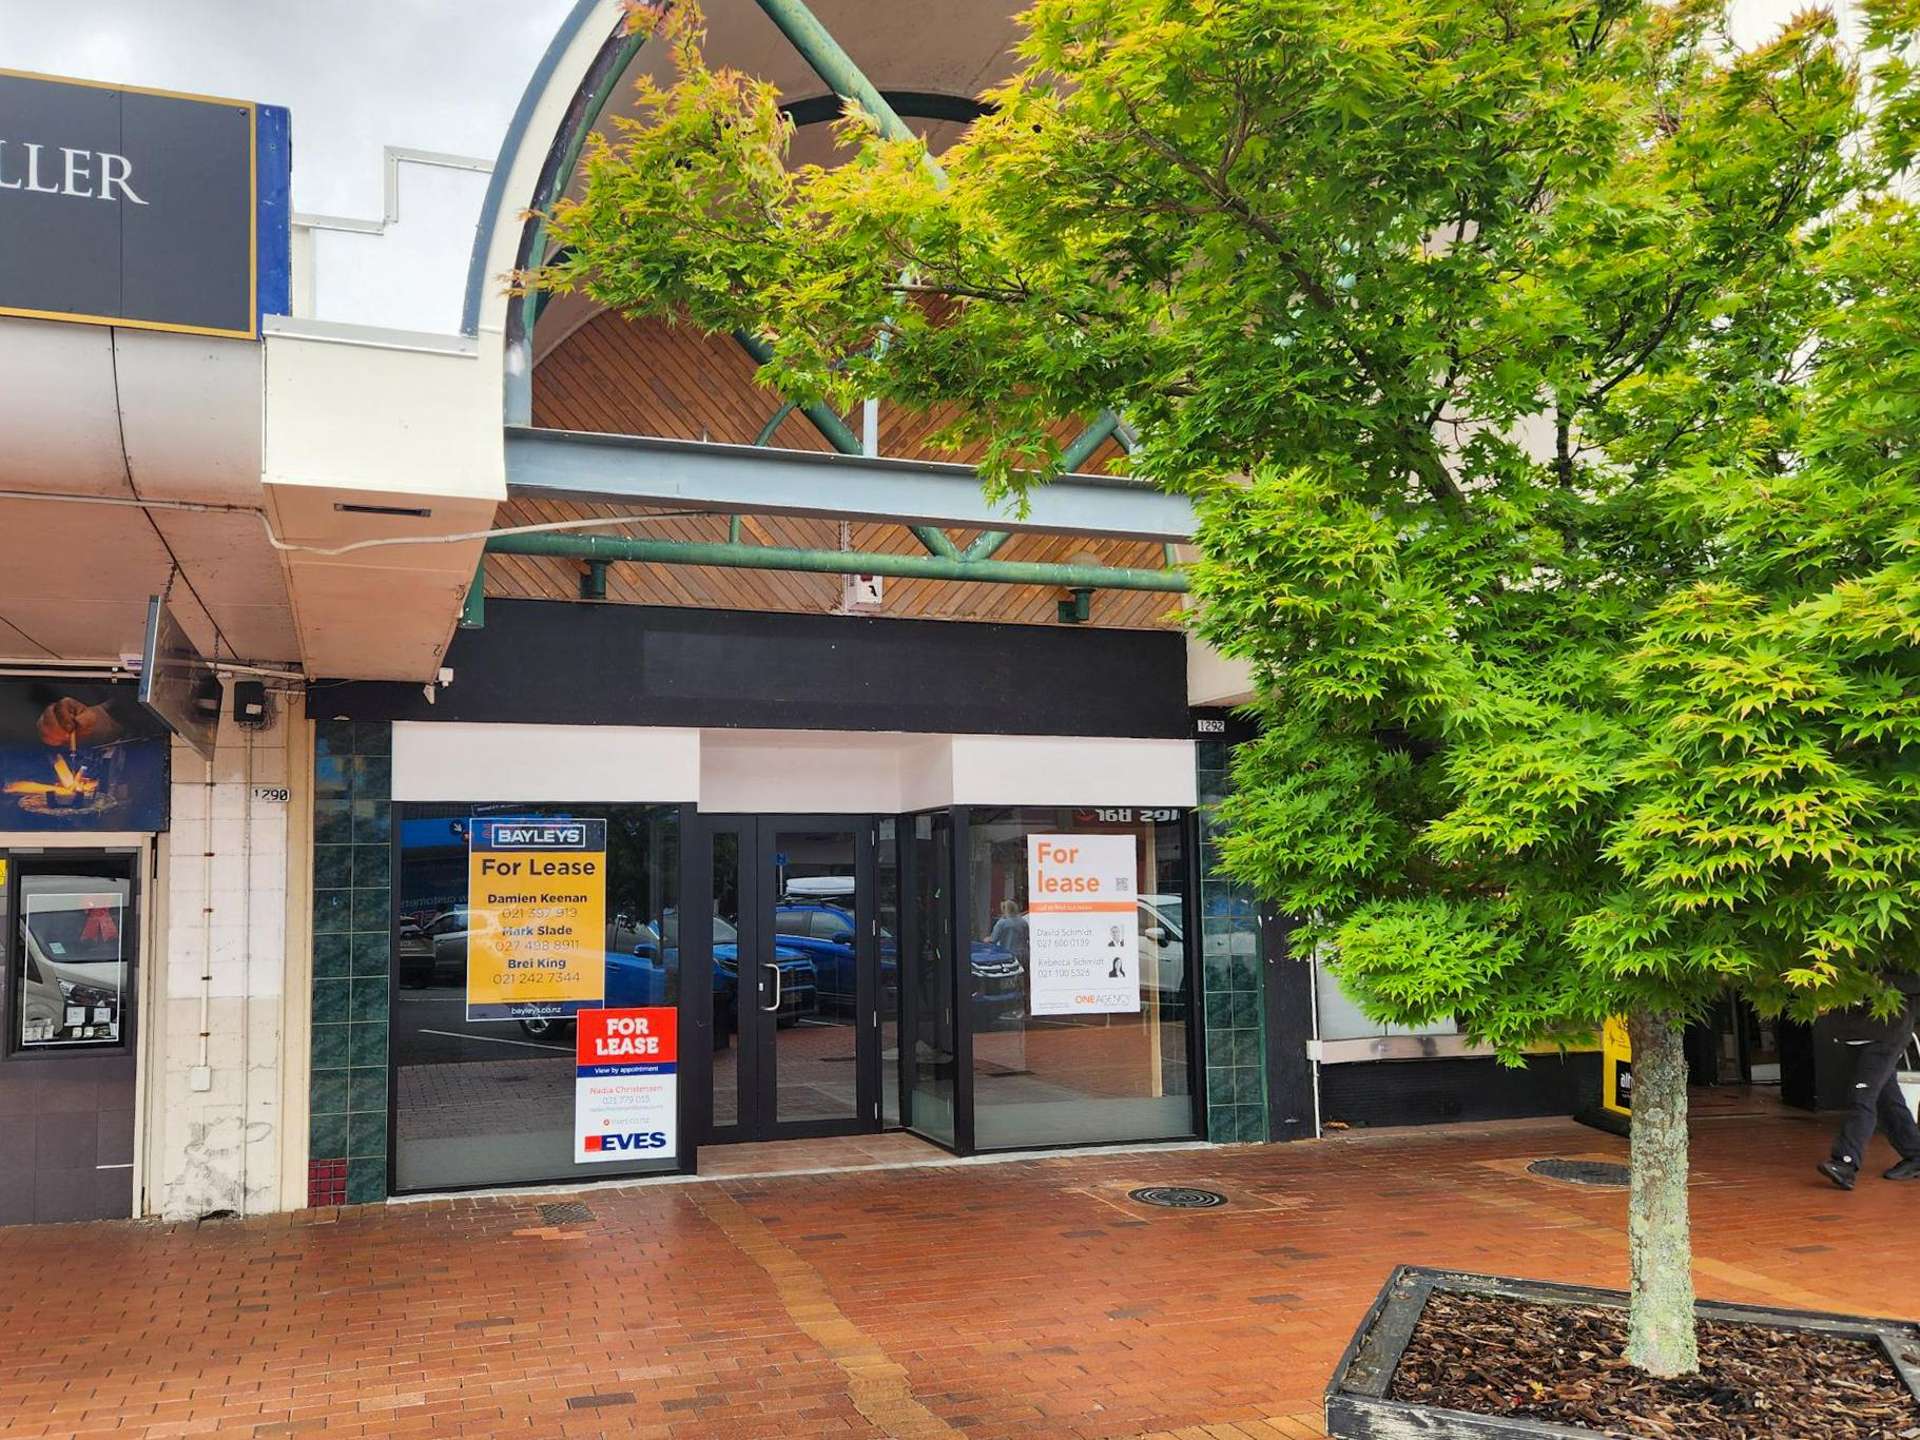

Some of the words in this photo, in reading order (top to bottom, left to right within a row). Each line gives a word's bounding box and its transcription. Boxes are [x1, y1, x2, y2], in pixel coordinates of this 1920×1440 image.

[1200, 721, 1224, 731] 1292
[254, 788, 288, 801] 1290
[498, 829, 580, 843] BAYLEYS
[1037, 842, 1078, 864] For
[481, 858, 522, 876] For
[529, 858, 596, 876] Lease
[1038, 870, 1100, 893] lease
[487, 893, 537, 904] Damien
[540, 893, 588, 904] Keenan
[502, 909, 524, 919] 021
[502, 926, 534, 936] Mark
[537, 925, 573, 936] Slade
[495, 941, 521, 952] 027
[508, 959, 534, 969] Brei
[537, 959, 566, 969] King
[492, 974, 515, 985] 021
[519, 973, 544, 984] 242
[548, 972, 581, 983] 7344
[606, 1018, 648, 1036] FOR
[595, 1037, 660, 1056] LEASE
[602, 1131, 667, 1152] EVES
